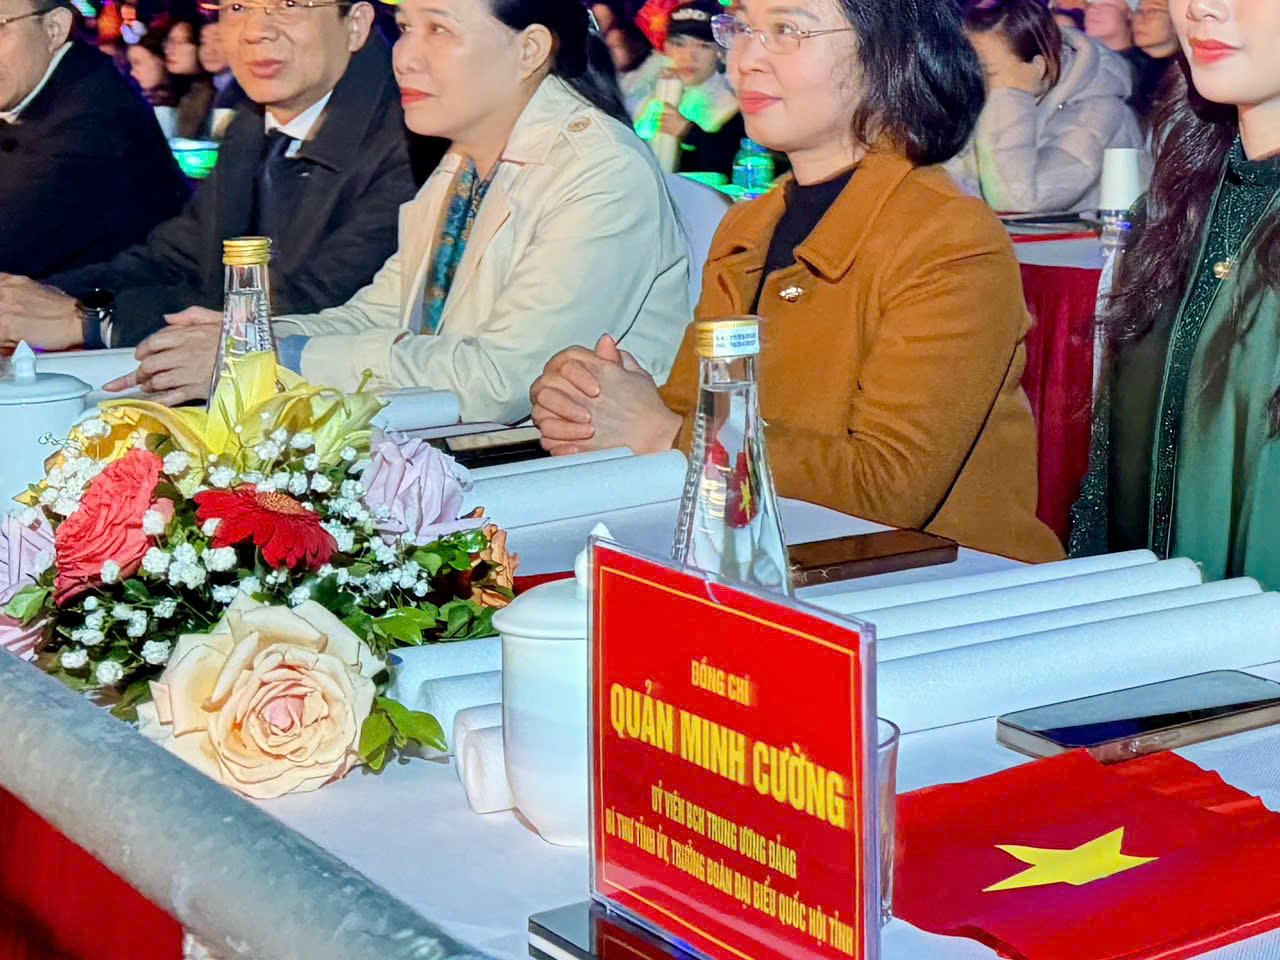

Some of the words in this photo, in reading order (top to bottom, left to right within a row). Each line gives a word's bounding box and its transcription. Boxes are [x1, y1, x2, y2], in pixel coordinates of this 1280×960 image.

[691, 655, 726, 697] ĐỒNG
[727, 673, 750, 706] CHÍ
[610, 678, 673, 754] QUẢN
[680, 709, 745, 785] MINH
[753, 741, 846, 828] CƯỜNG
[606, 806, 616, 836] BÍ
[616, 812, 634, 844] THƯ
[671, 839, 705, 882] TRƯỞNG
[707, 858, 733, 896] ĐOÀN
[734, 871, 751, 909] ĐẠI
[753, 875, 777, 917] BIỂU
[779, 891, 806, 932] QUỐC
[808, 905, 826, 945] HỘI
[664, 790, 686, 825] VIÊN
[686, 801, 705, 835] BCH
[706, 809, 738, 852] TRUNG
[739, 826, 767, 865] ƯƠNG
[768, 833, 797, 879] ĐẢNG
